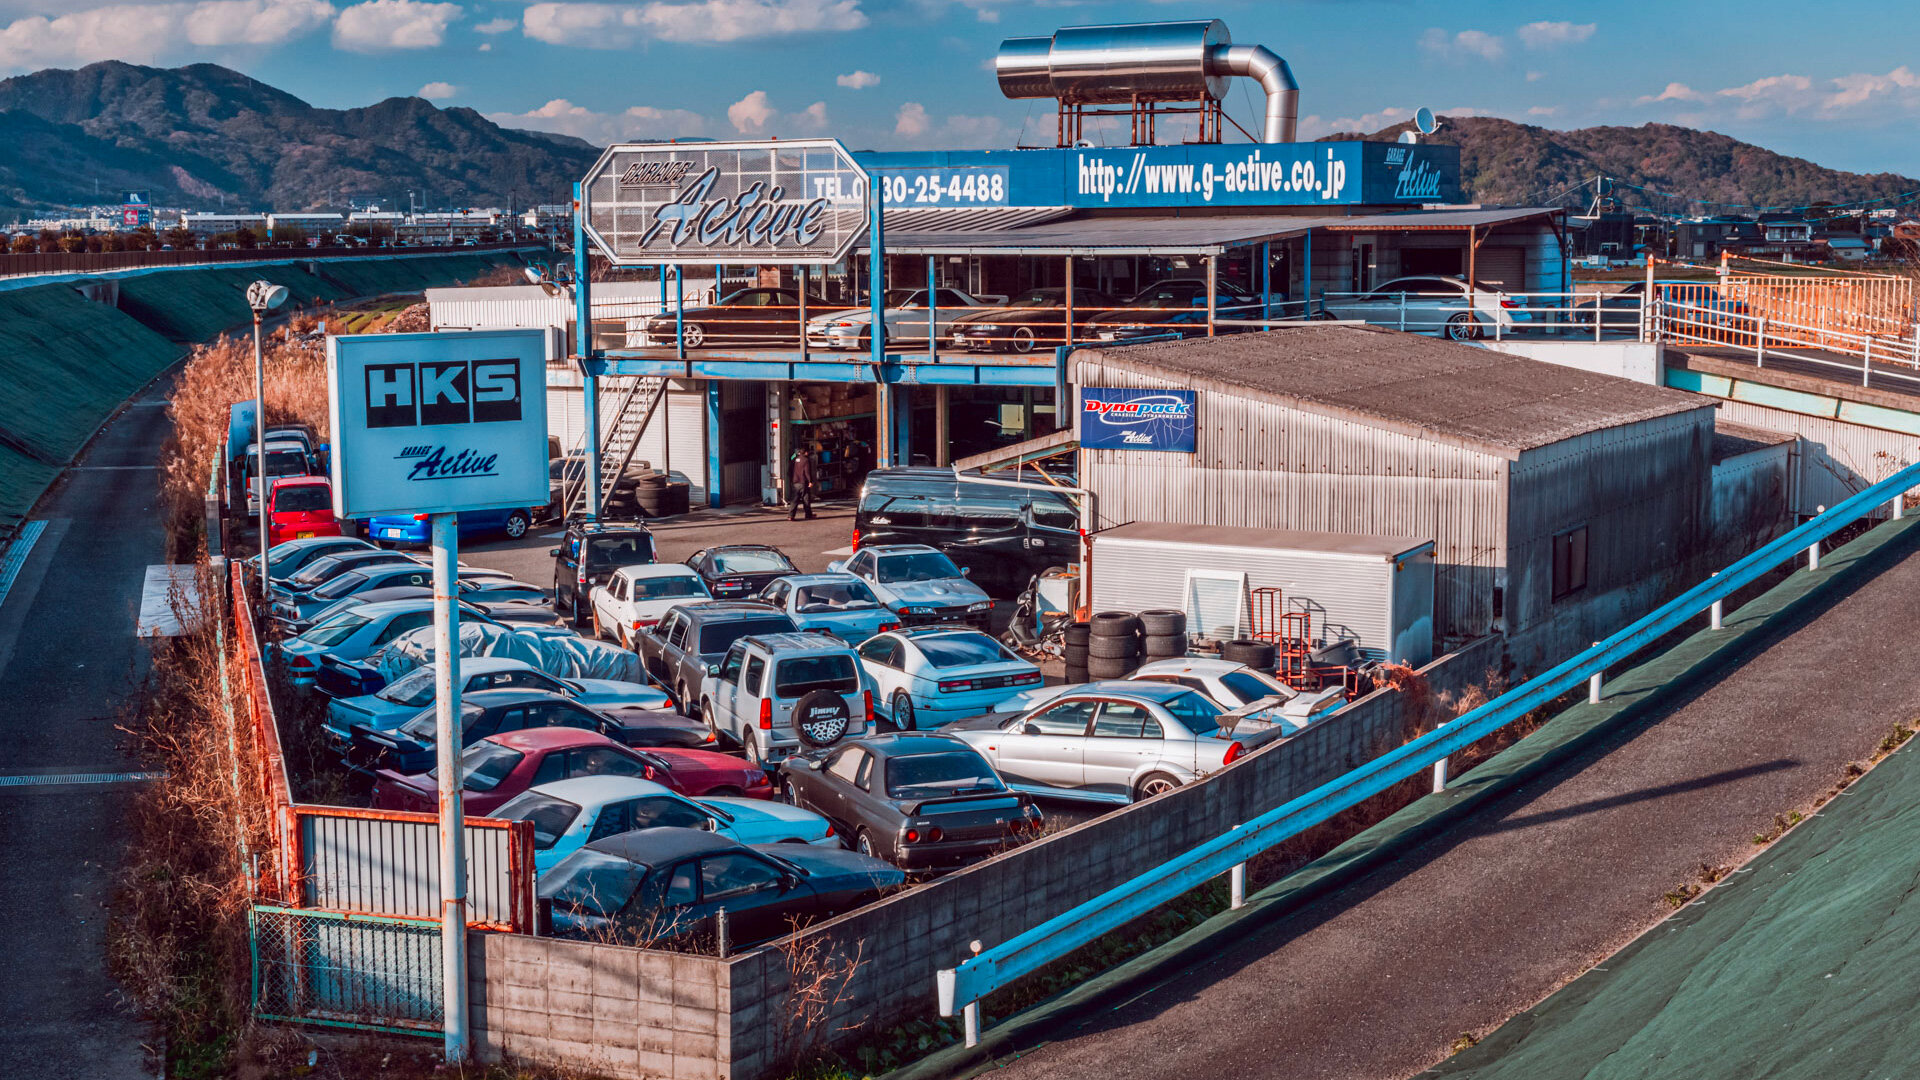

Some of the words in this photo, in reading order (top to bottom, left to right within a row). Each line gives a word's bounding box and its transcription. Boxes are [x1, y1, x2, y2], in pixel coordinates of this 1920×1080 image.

[619, 160, 696, 184] GARAGE
[1078, 148, 1346, 202] http://www.g-active.co.jp
[1394, 149, 1441, 198] Active
[637, 165, 831, 248] Active
[368, 363, 518, 409] HKS
[1084, 399, 1190, 417] Dynapack
[400, 445, 432, 457] GARAGE
[407, 446, 498, 481] Active
[809, 706, 840, 718] Jimny
